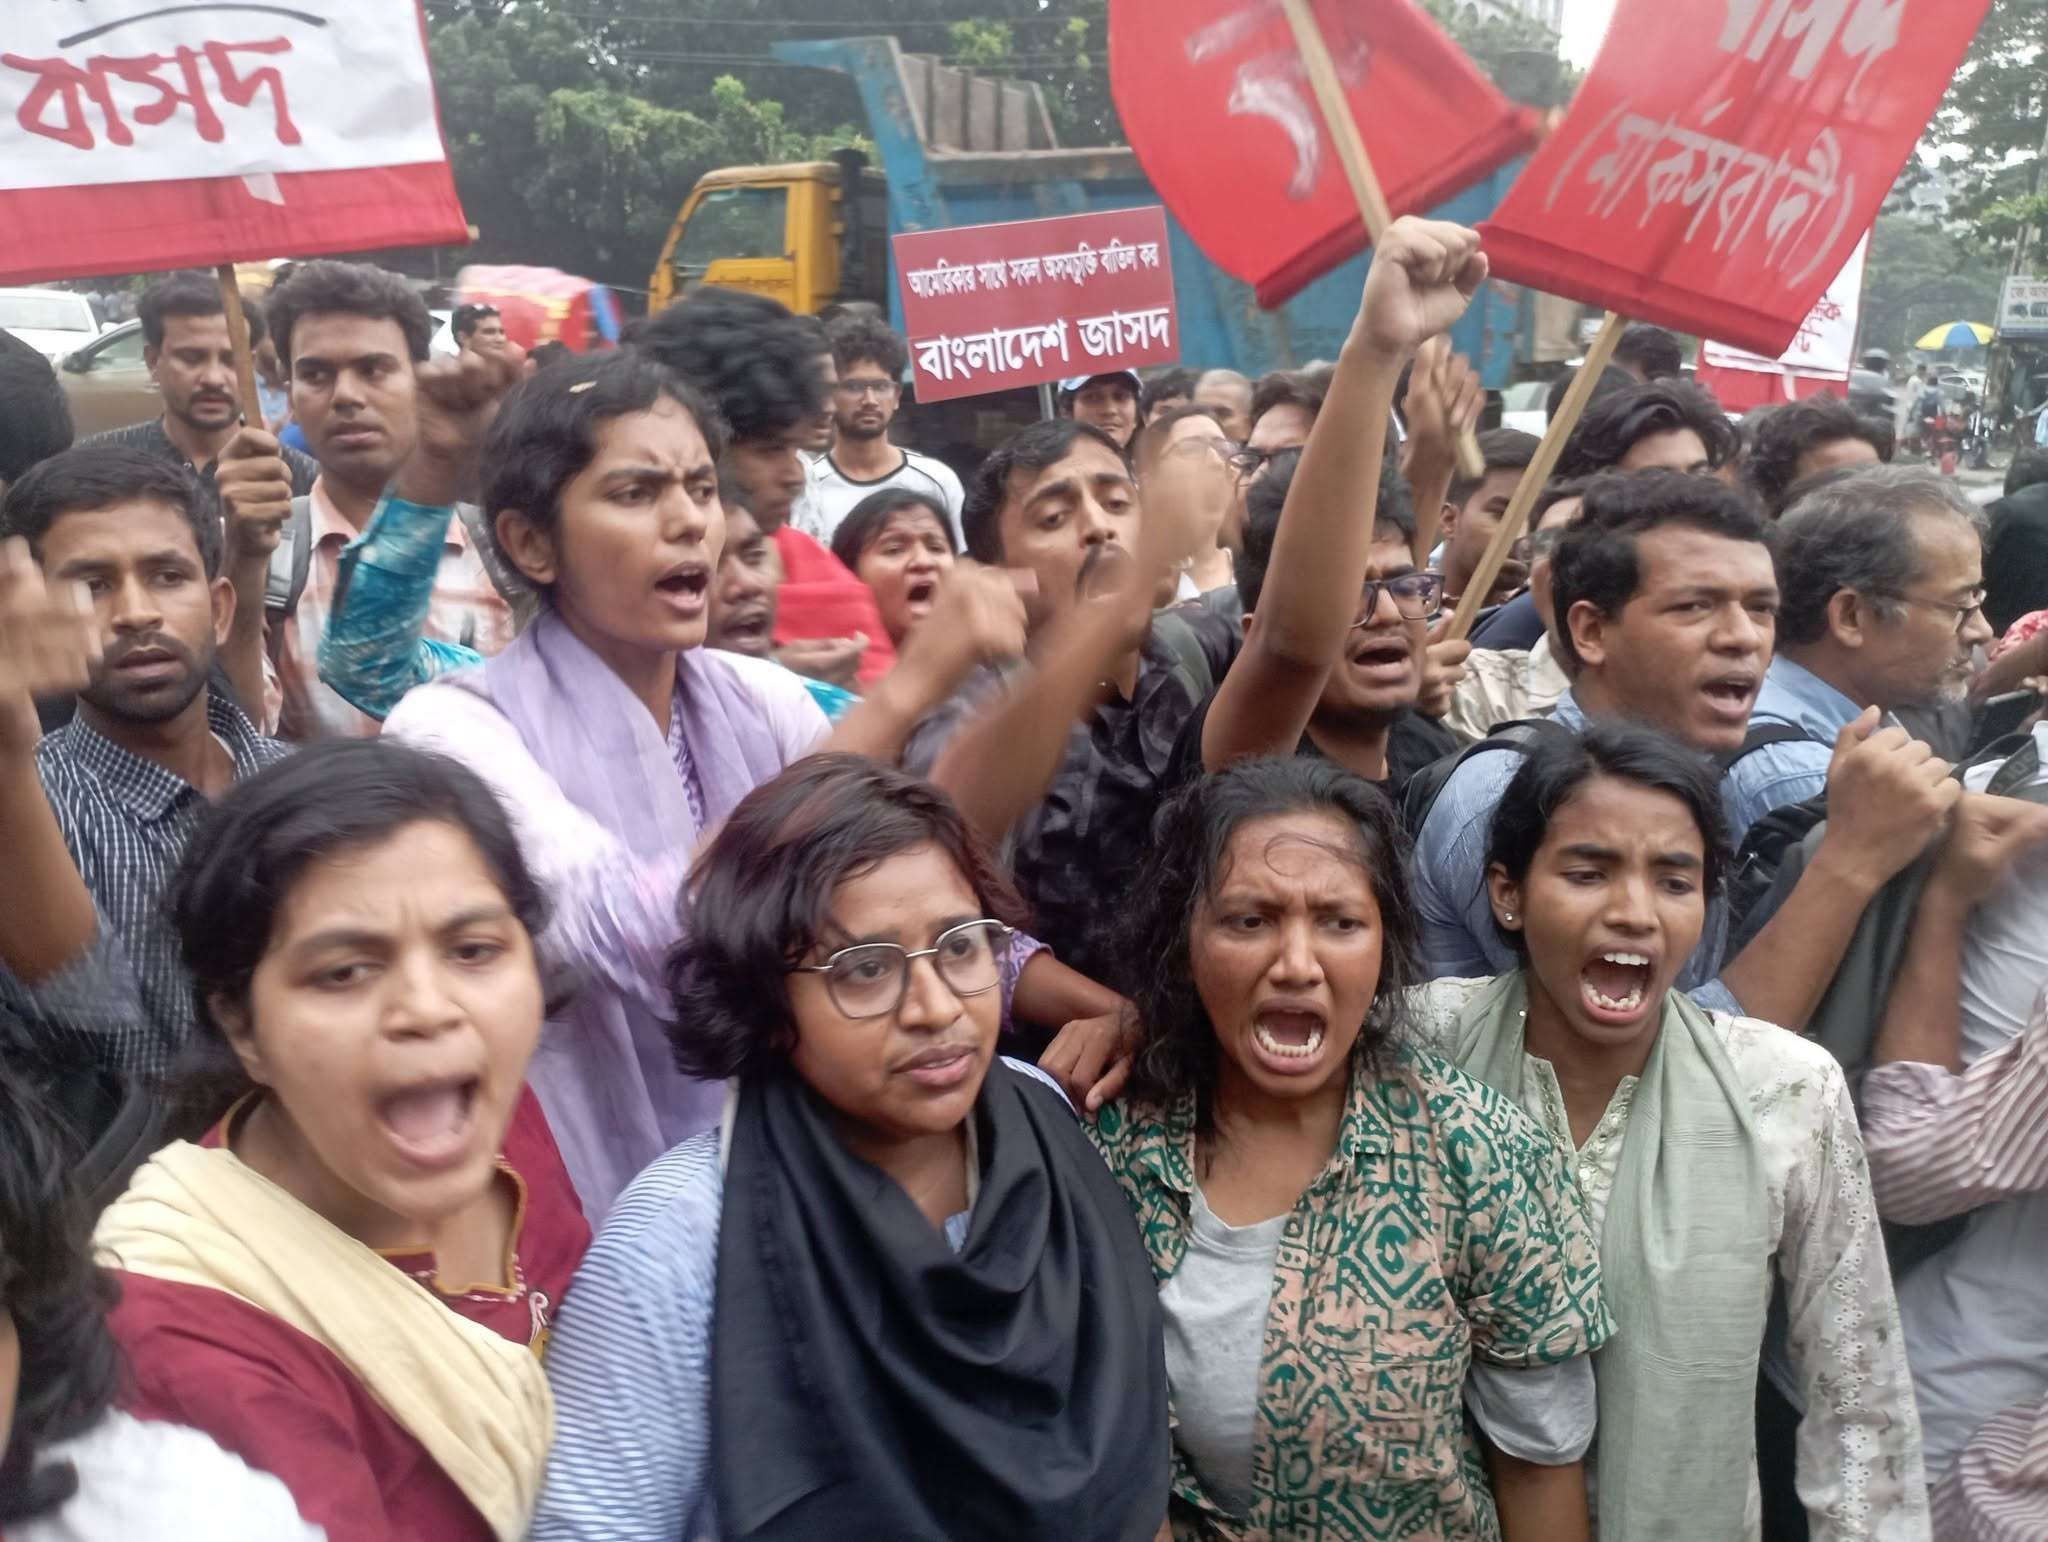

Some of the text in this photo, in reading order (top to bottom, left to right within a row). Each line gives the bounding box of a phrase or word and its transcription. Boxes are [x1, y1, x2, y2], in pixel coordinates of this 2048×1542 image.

[1, 36, 303, 150] বাসদ
[1007, 256, 1042, 286] সকল
[914, 307, 1170, 381] বাংলাদেশ জাসদ
